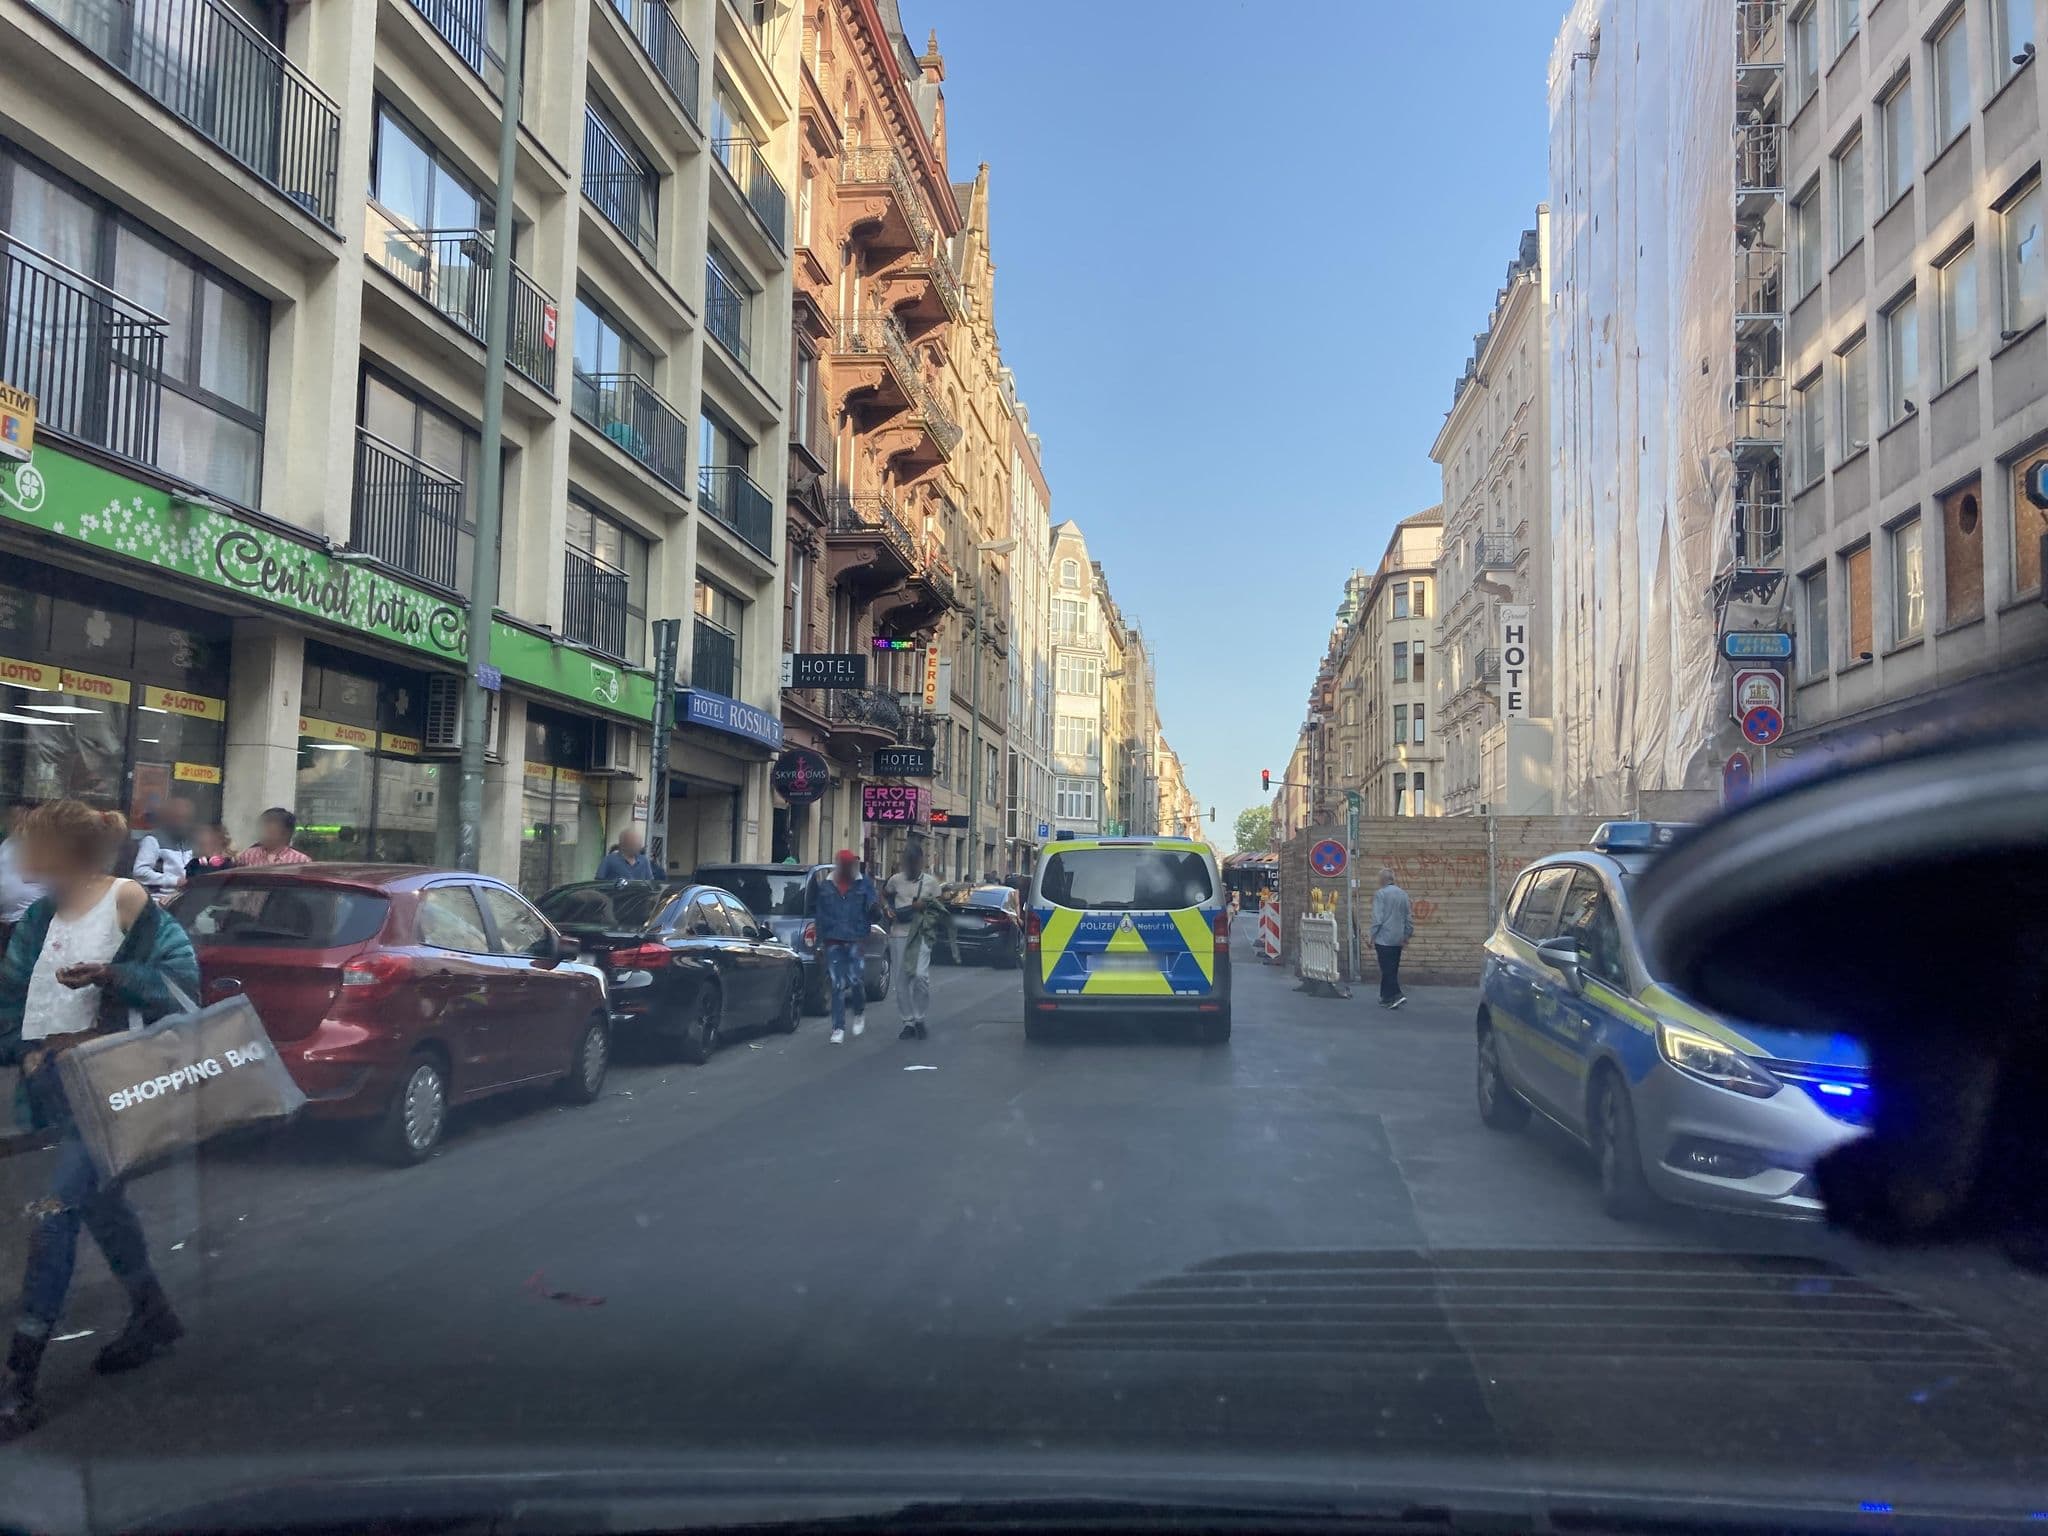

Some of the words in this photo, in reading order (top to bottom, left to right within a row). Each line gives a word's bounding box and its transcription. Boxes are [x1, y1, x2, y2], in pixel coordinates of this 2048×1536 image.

[0, 387, 30, 412] ATM
[215, 531, 354, 619] Central
[367, 579, 420, 635] lotto
[429, 607, 469, 657] Ca
[1, 662, 42, 682] LOTTO
[780, 660, 791, 682] 44
[801, 660, 855, 673] HOTEL
[1505, 625, 1525, 717] HOTE
[77, 679, 113, 698] LOTTO
[926, 658, 937, 705] EROS
[174, 697, 206, 713] LOTTO
[693, 698, 724, 719] HOTEL
[729, 704, 771, 740] ROSSIJA
[344, 729, 366, 742] LOTTO
[399, 739, 419, 752] LOTTO
[880, 754, 923, 766] HOTEL
[775, 769, 826, 780] SKYROOMS
[1040, 825, 1047, 836] P
[1080, 922, 1116, 931] POLIZEI
[1162, 922, 1175, 930] 110
[108, 1058, 224, 1112] SHOPPING
